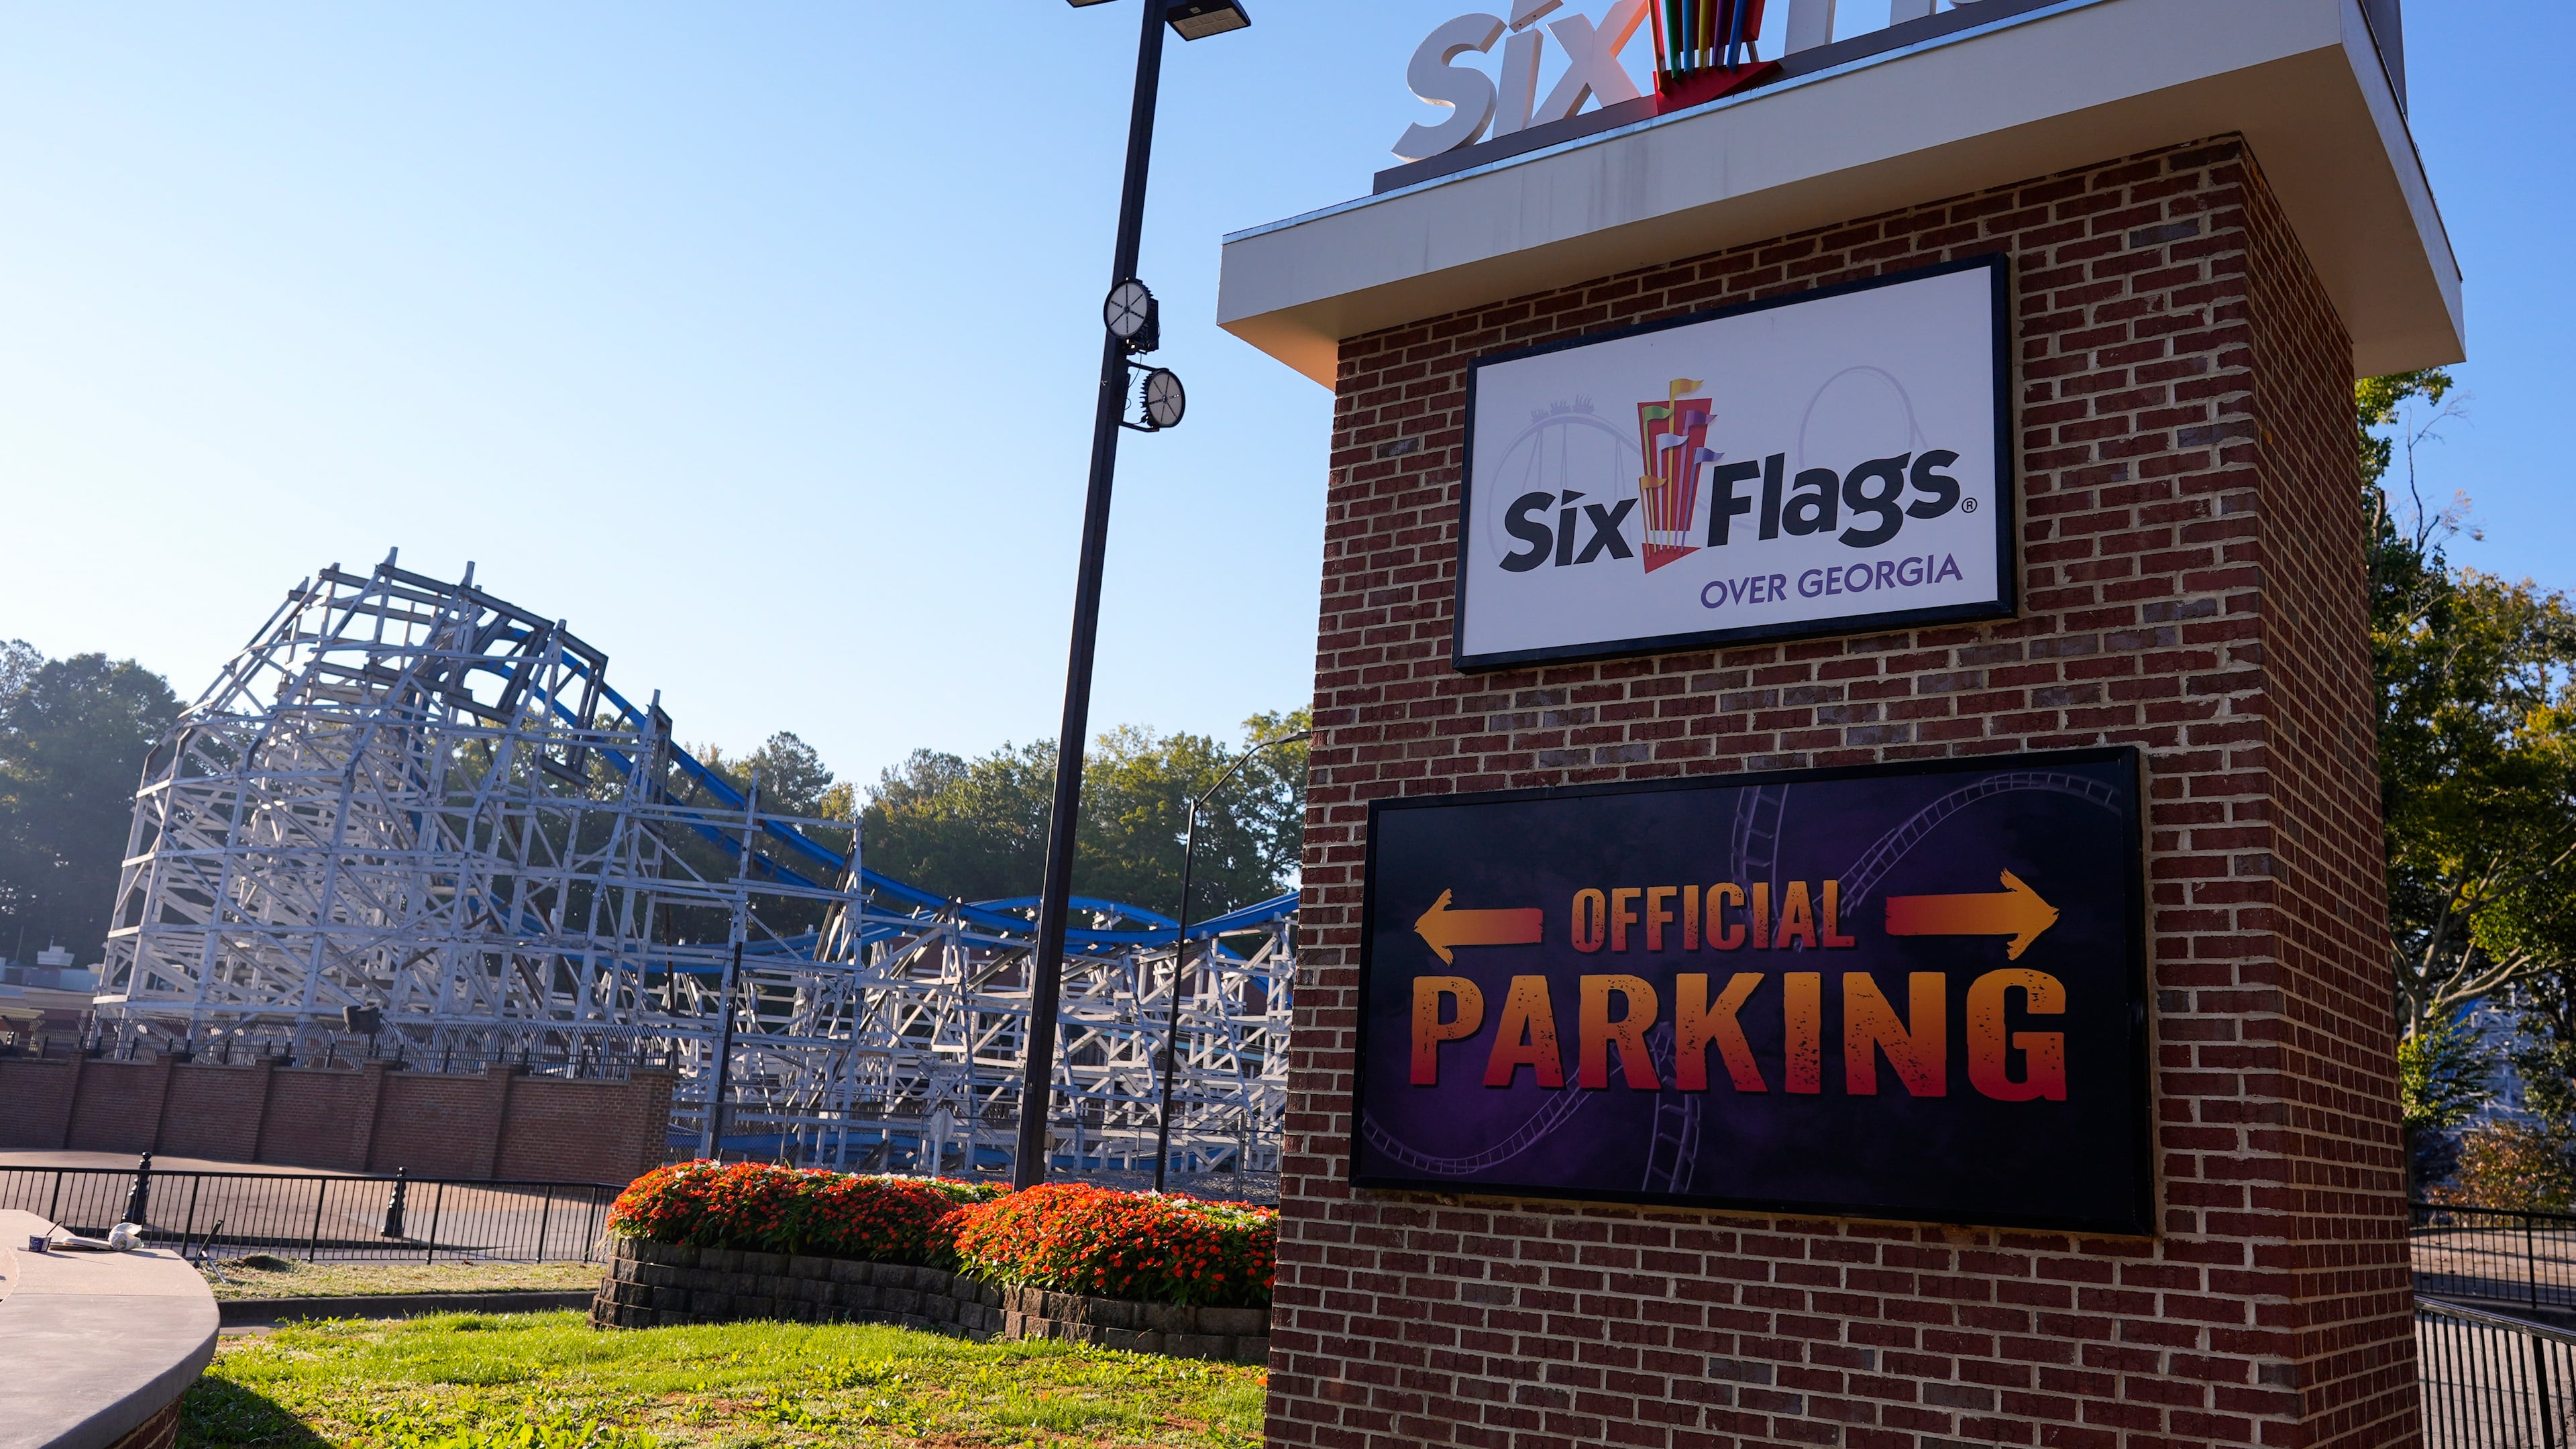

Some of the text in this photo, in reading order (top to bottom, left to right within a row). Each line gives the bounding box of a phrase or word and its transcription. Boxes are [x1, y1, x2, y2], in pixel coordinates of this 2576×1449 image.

[1499, 489, 1639, 573] Six
[1700, 552, 1964, 609] OVER GEORGIA
[1570, 879, 1856, 953] OFFICIAL
[1409, 967, 2068, 1102] PARKING
